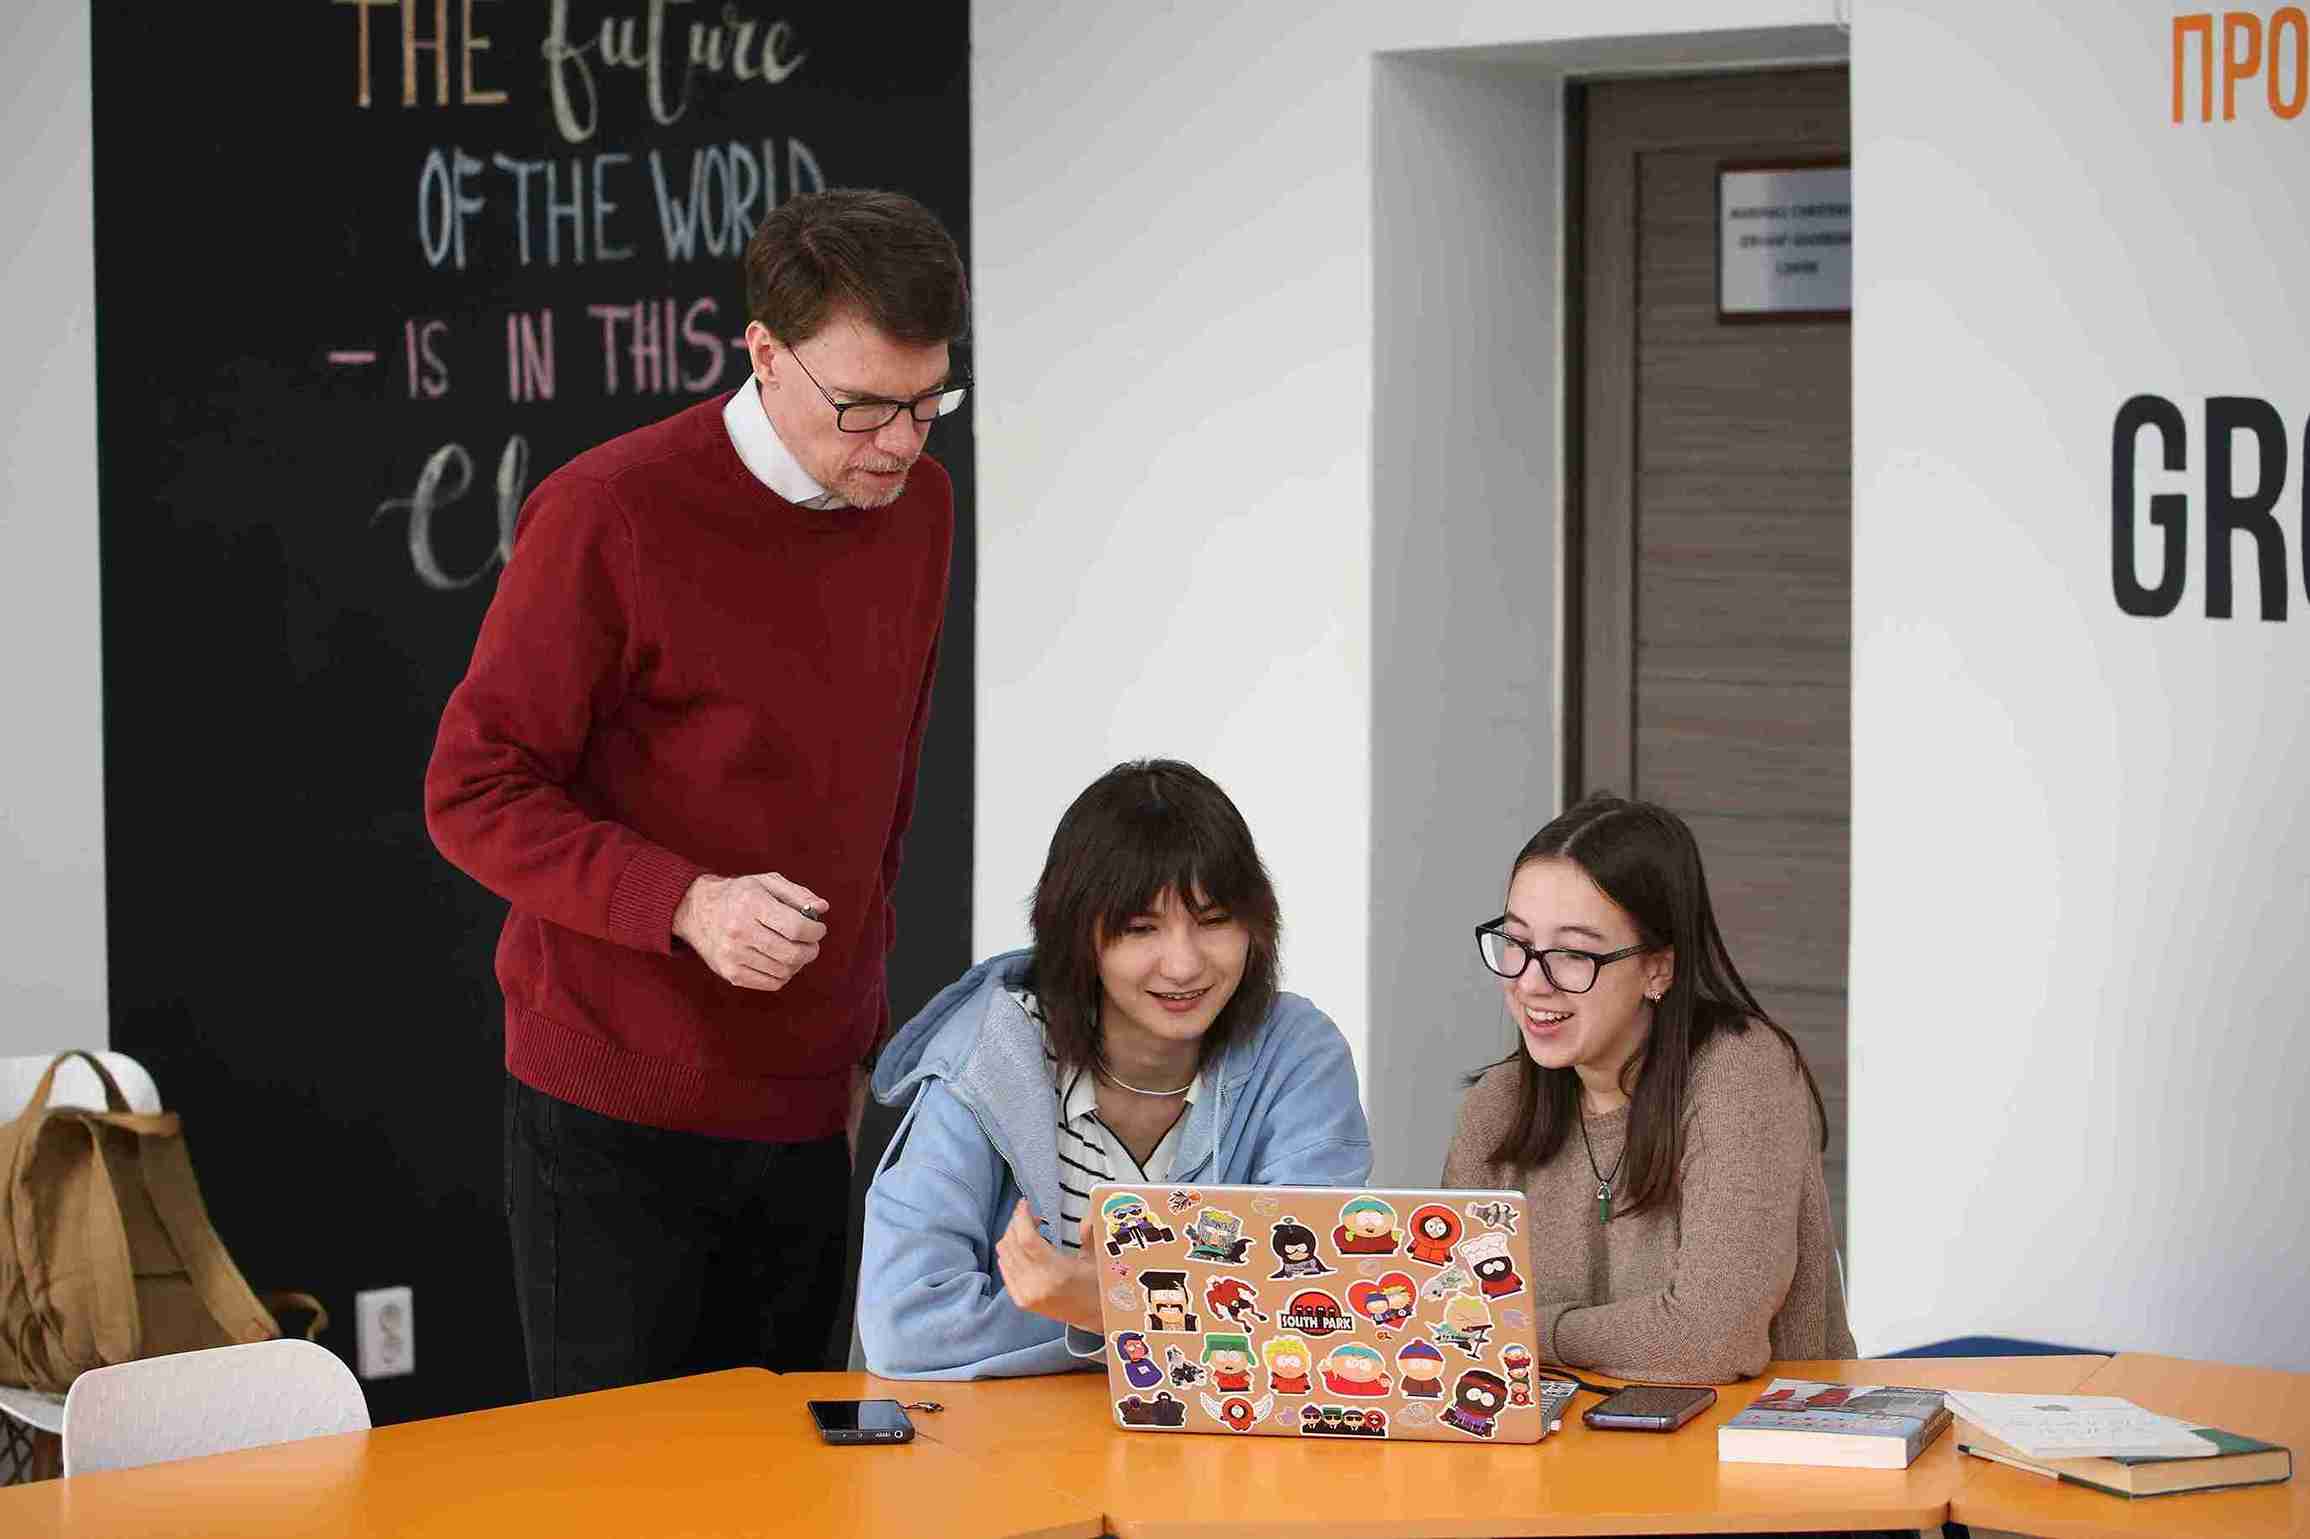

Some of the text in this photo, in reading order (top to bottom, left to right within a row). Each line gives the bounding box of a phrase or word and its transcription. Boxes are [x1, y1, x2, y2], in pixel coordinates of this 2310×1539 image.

[332, 0, 806, 142] THE future
[2172, 6, 2309, 124] ПРО
[419, 146, 486, 269] OF
[494, 153, 634, 266] THE
[404, 297, 726, 402] IS IN THIS
[2111, 393, 2310, 621] GR
[1282, 1315, 1351, 1329] SOUTH PARK
